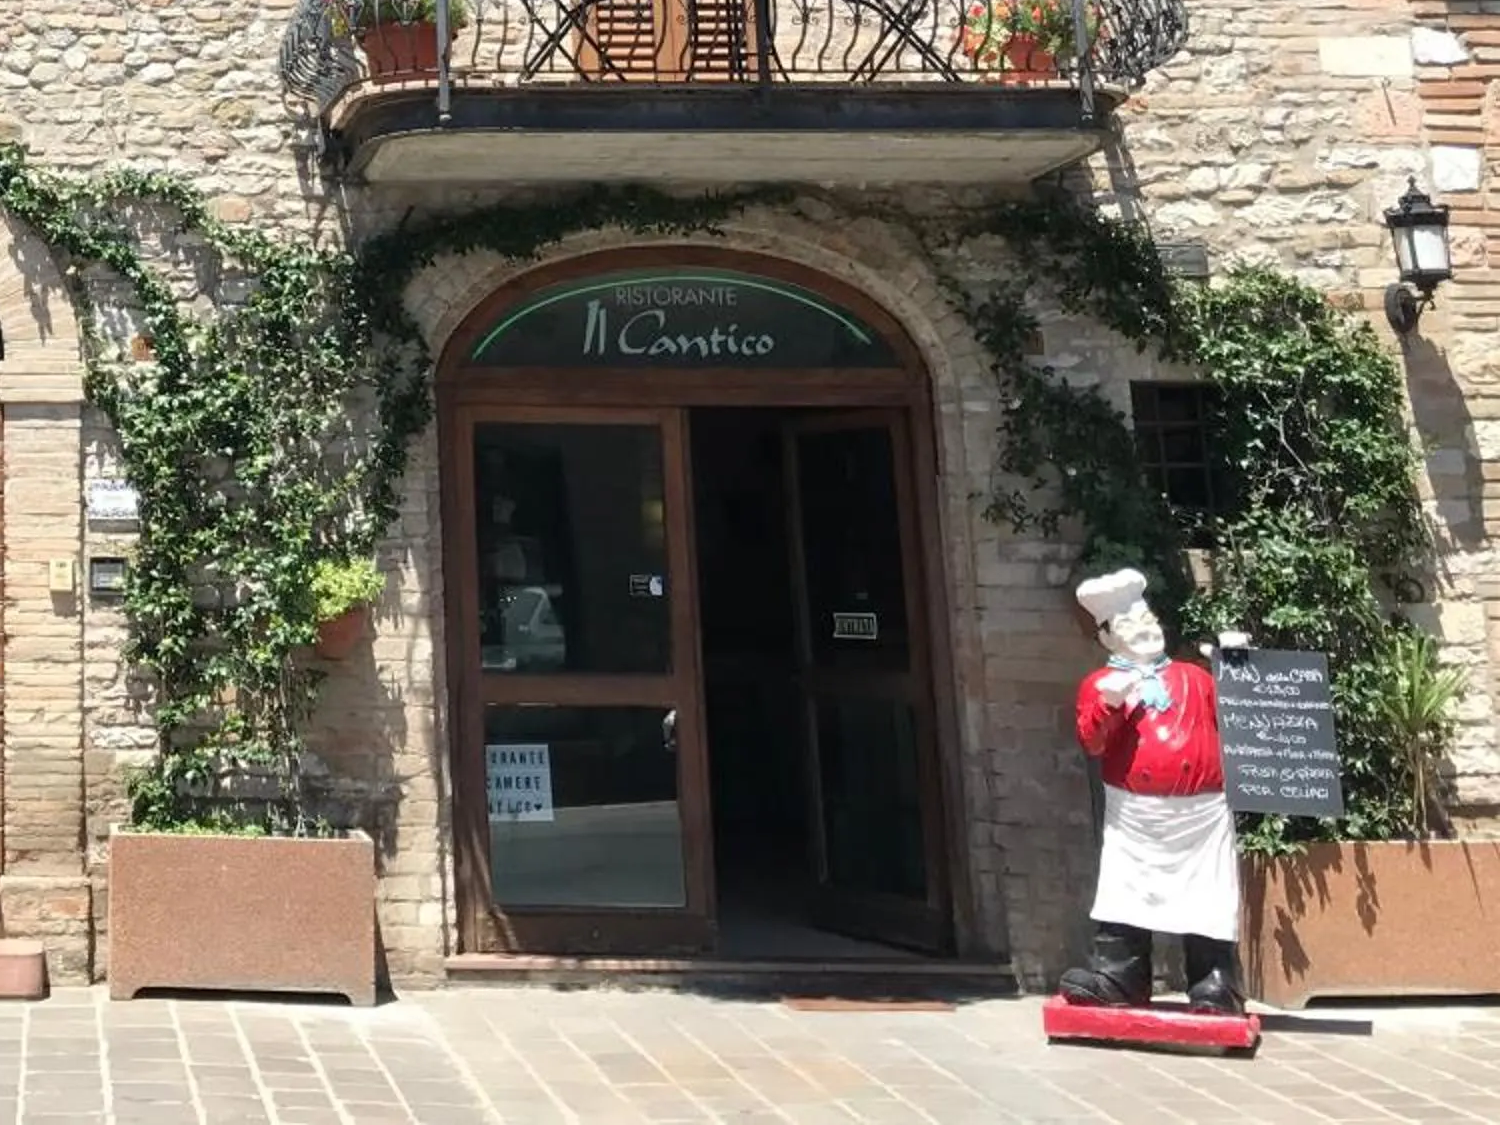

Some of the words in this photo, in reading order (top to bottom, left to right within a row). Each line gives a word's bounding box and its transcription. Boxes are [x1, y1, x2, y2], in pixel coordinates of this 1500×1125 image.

[615, 287, 738, 307] RISTORANTE
[583, 299, 607, 356] Il
[618, 308, 775, 359] Cantico
